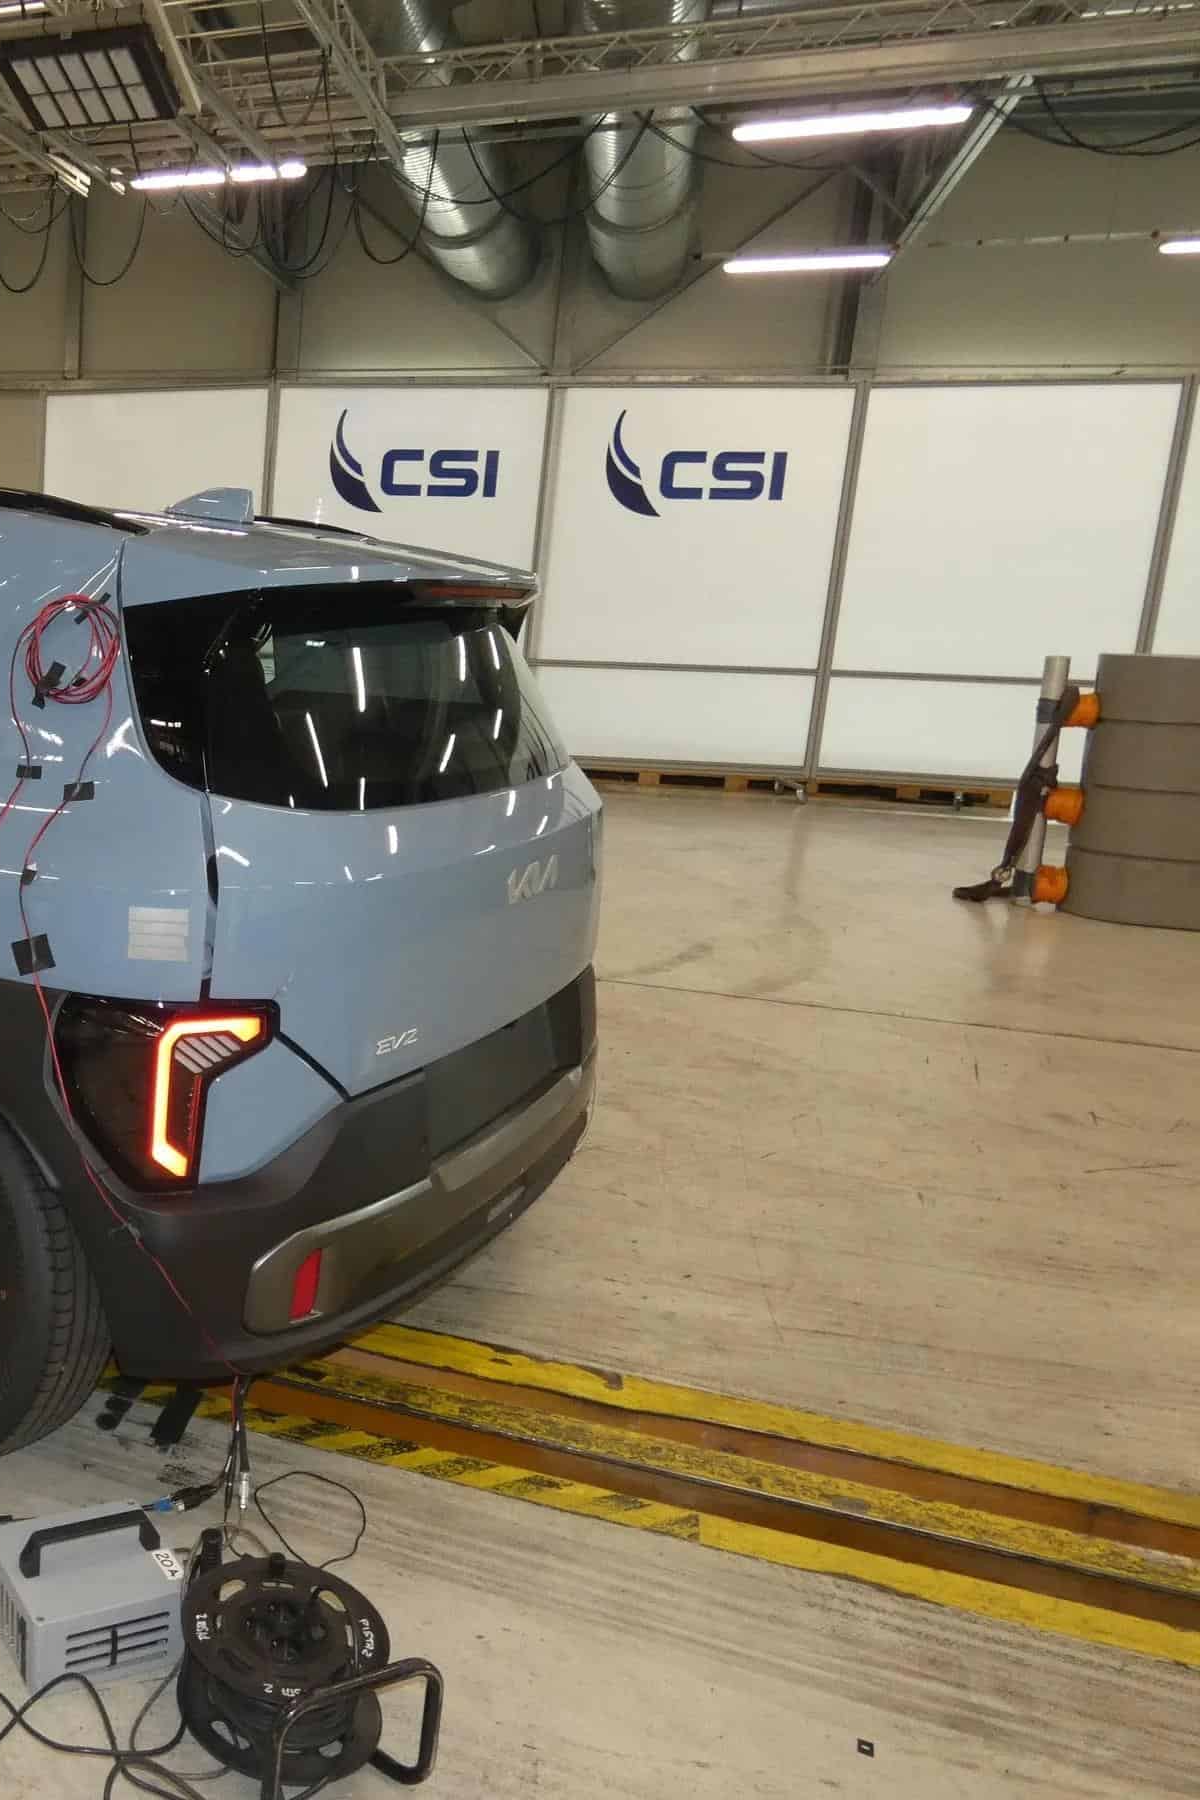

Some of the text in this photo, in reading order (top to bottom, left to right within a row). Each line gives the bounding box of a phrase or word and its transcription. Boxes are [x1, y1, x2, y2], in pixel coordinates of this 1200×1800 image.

[380, 449, 499, 497] CSI
[659, 450, 788, 500] CSI
[376, 1028, 418, 1056] EV2
